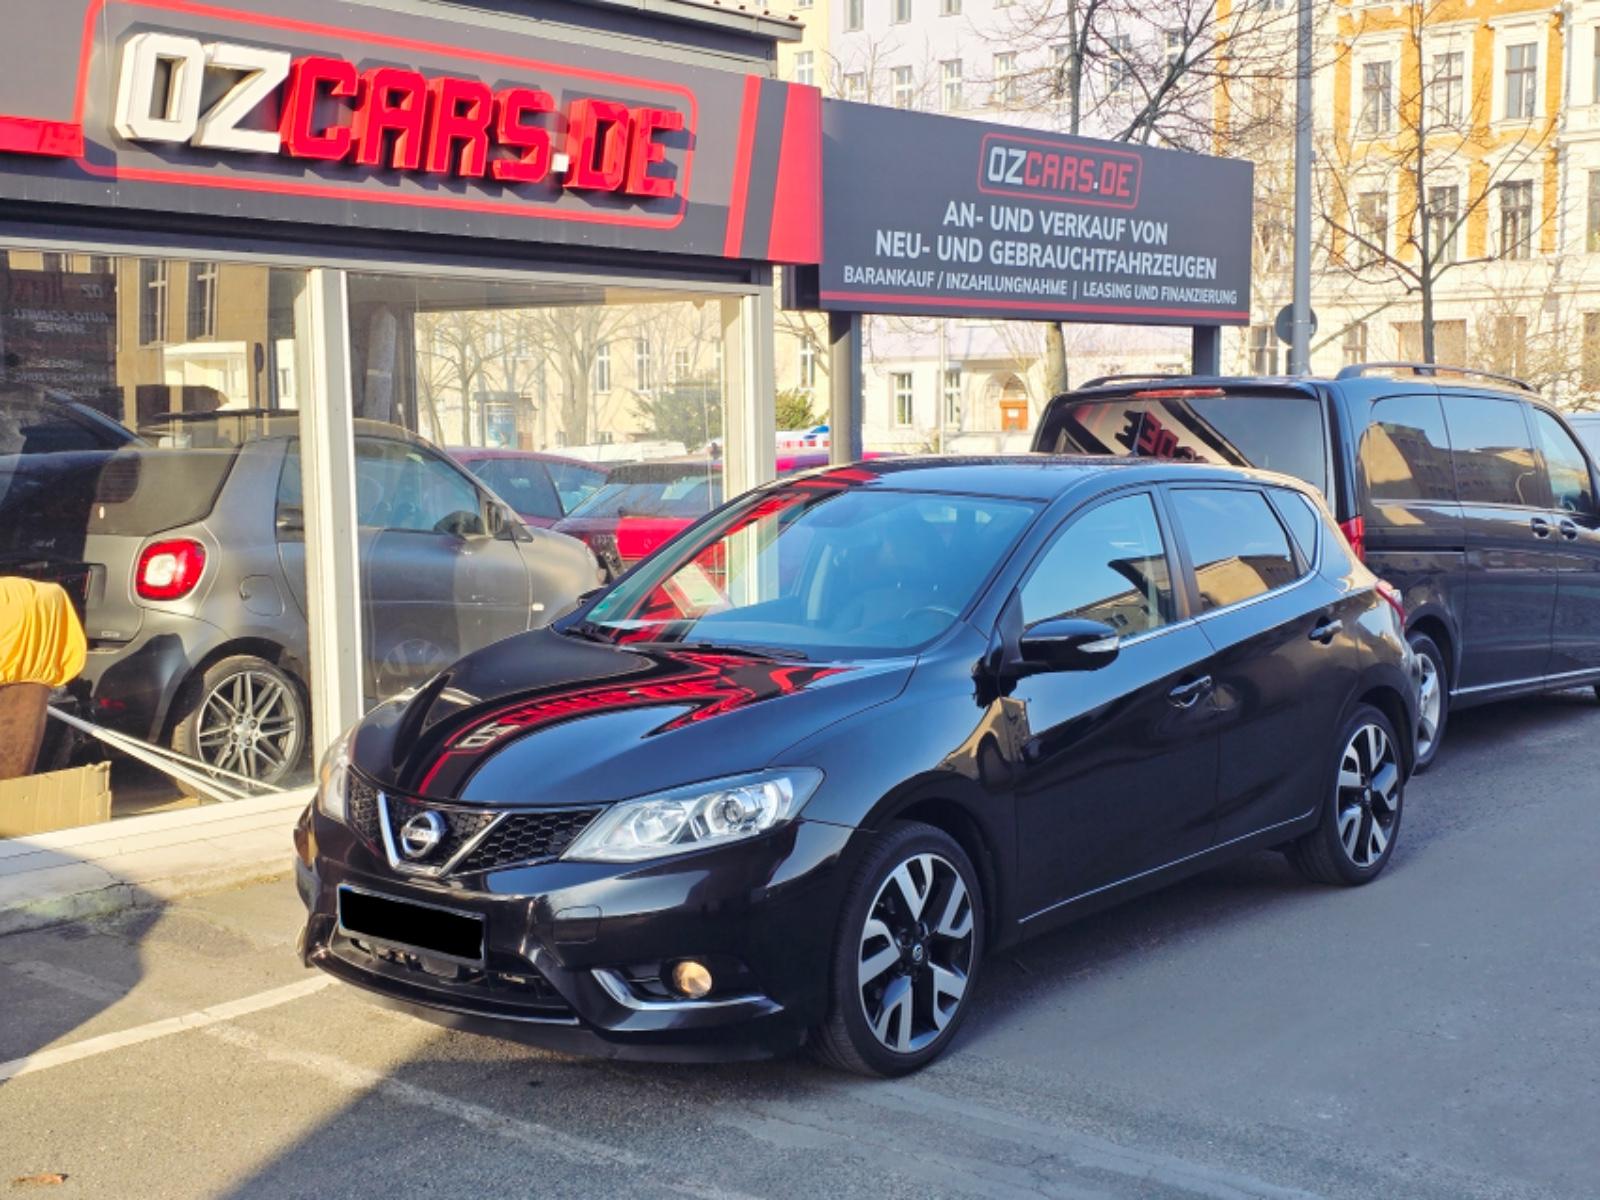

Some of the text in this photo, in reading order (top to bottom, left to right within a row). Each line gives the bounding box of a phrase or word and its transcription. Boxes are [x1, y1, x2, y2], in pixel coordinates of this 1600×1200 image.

[114, 31, 684, 198] OZCARS.DE
[987, 146, 1133, 197] OZCARS.DE
[943, 200, 1169, 246] AN- UND VERKAUF VON
[875, 229, 1217, 280] NEU- UND GEBRAUCHTFAHRZEUGEN
[843, 265, 936, 289] BARANKAUF
[946, 272, 1068, 297] INZAHLUNGNAHME
[1083, 281, 1132, 300] LEASING
[1134, 285, 1159, 302] UND
[1161, 286, 1237, 305] FINANZIERUNG
